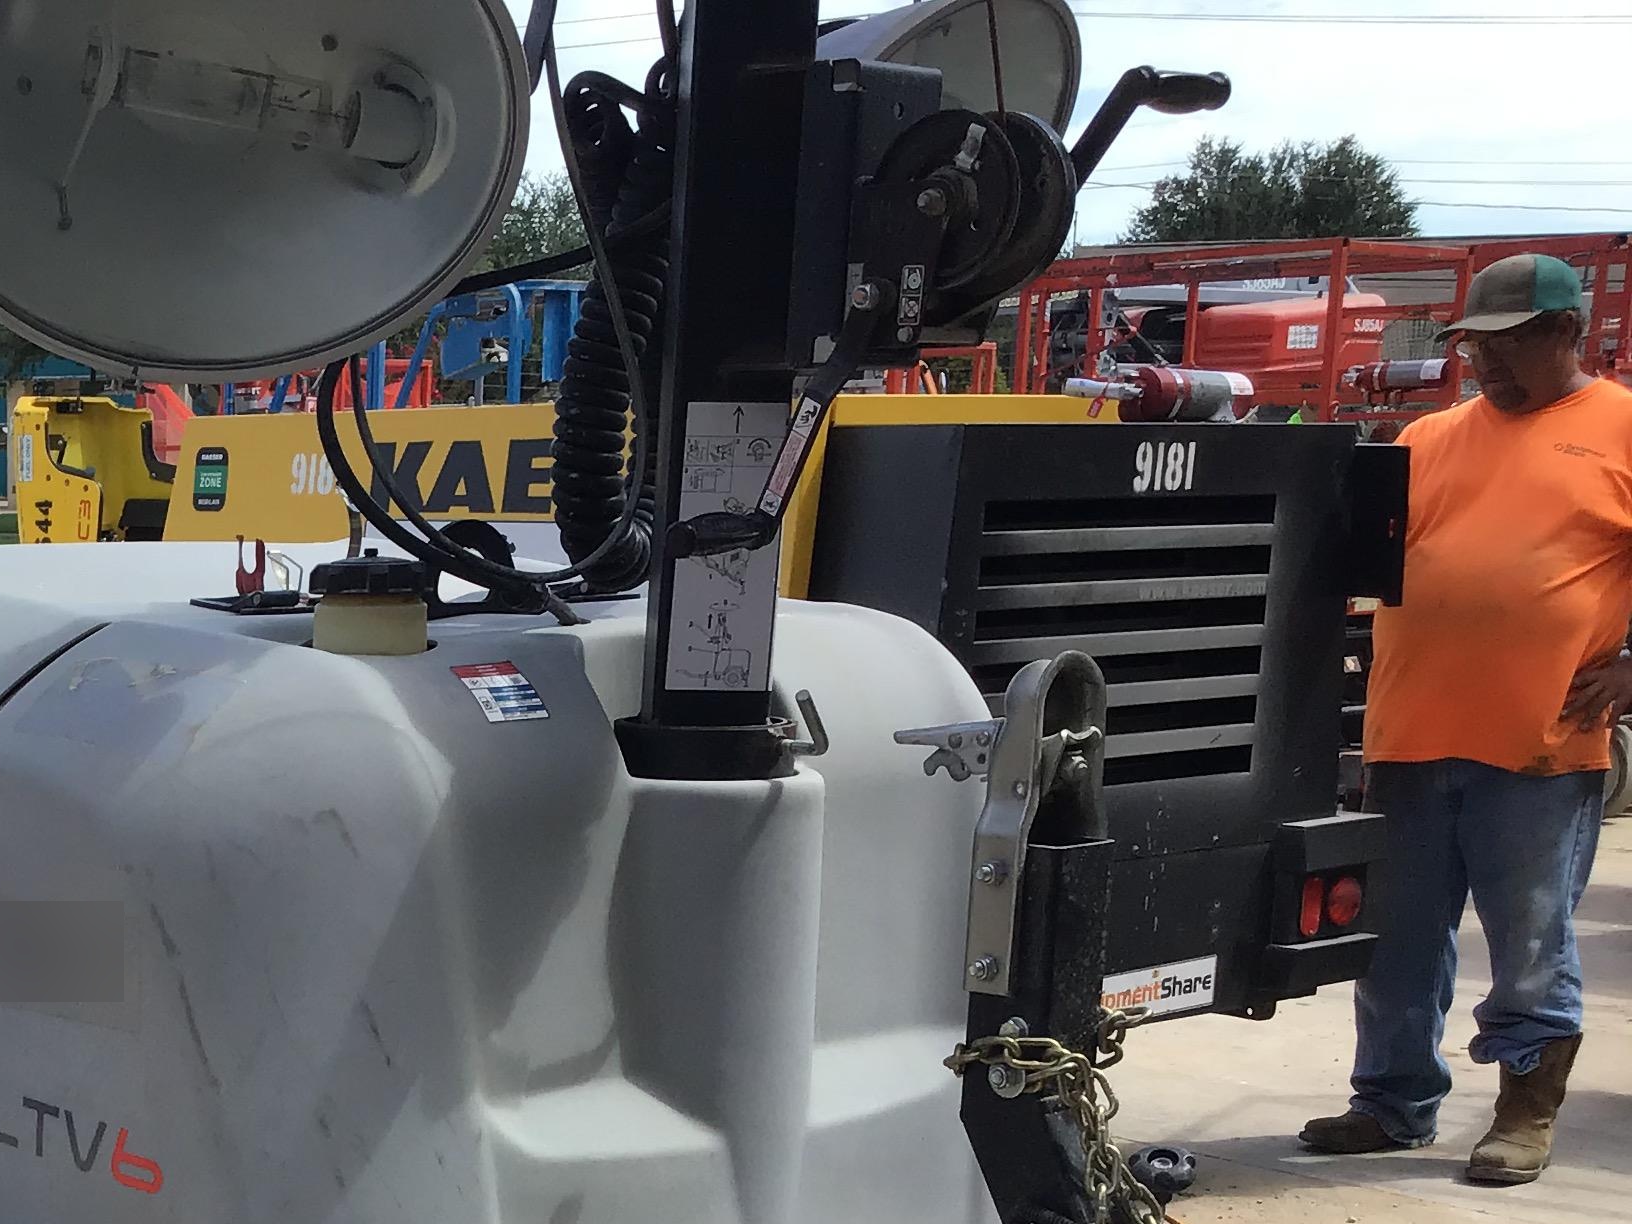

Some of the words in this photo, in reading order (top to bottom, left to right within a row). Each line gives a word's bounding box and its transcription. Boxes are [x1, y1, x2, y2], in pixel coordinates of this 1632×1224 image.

[199, 476, 222, 488] ZONE
[290, 452, 336, 496] 918
[370, 438, 555, 513] KAE
[1133, 441, 1197, 493] 9181
